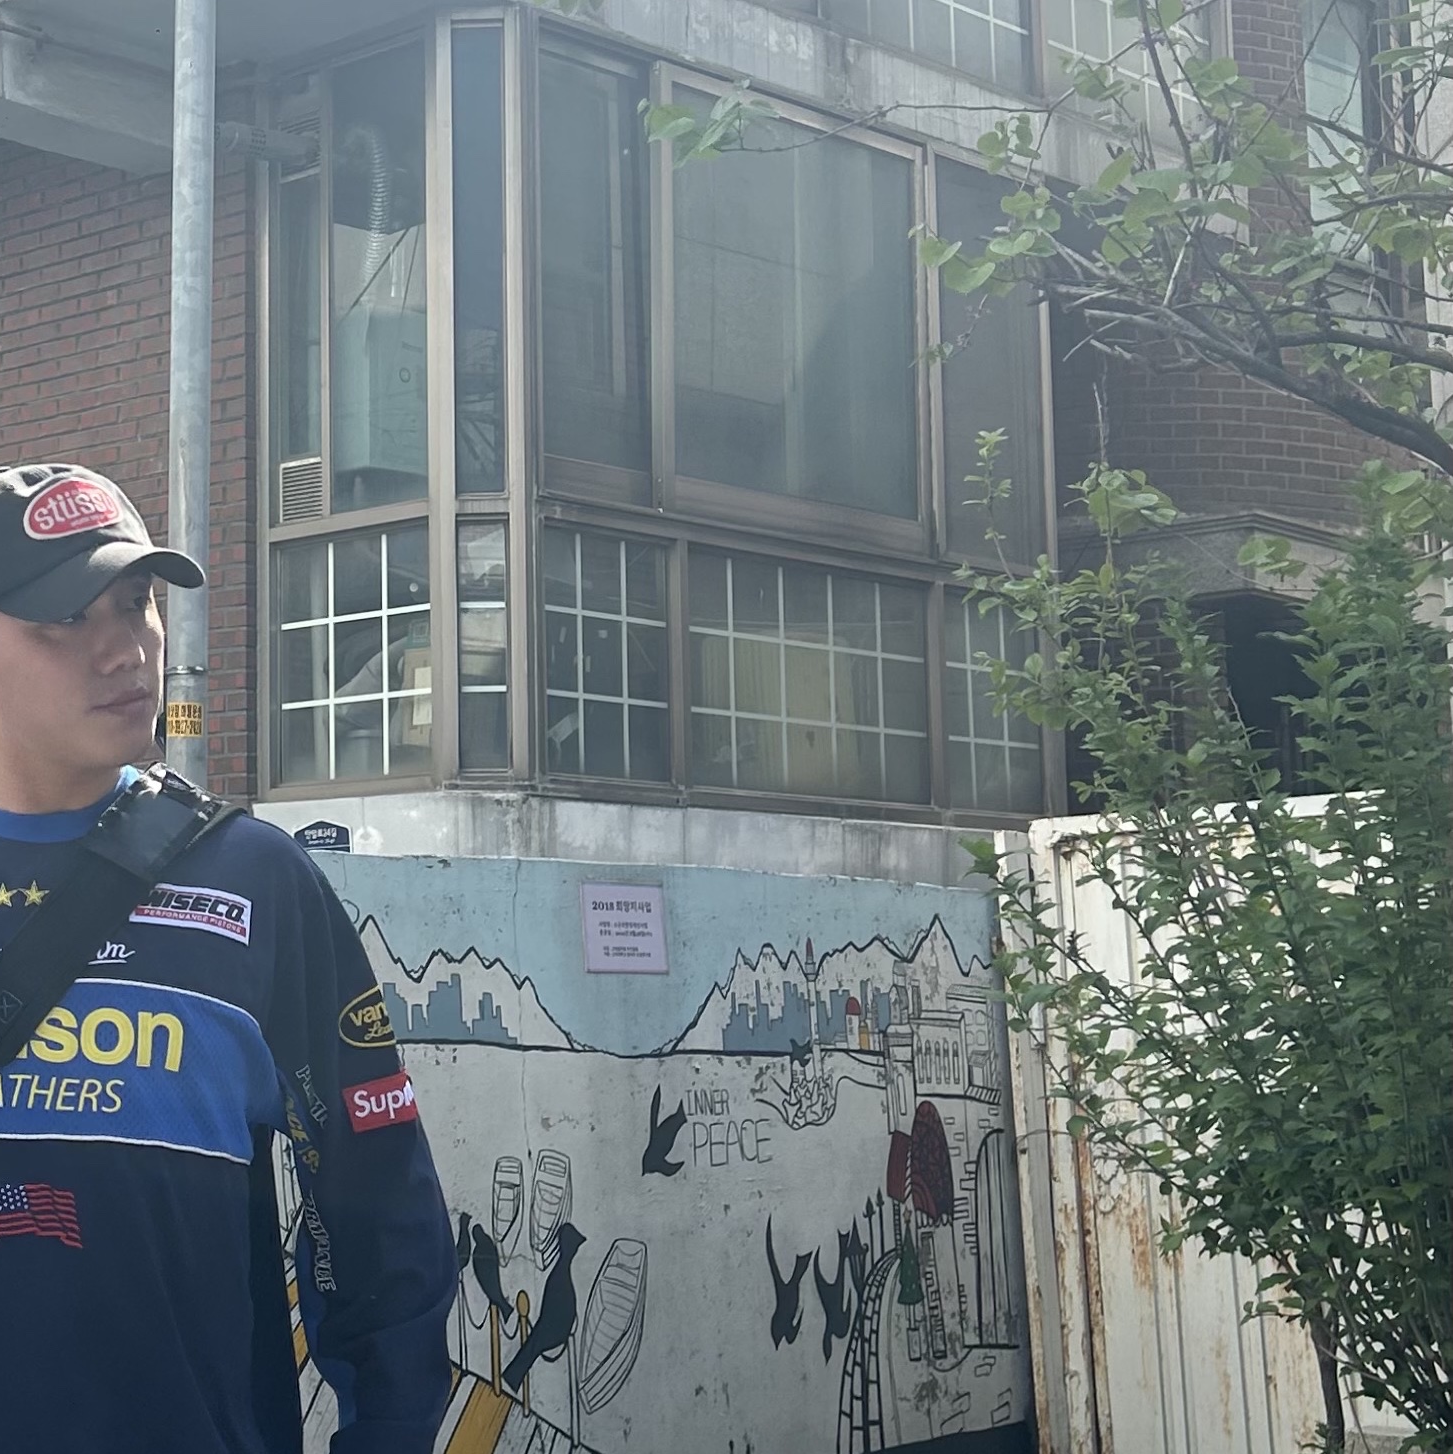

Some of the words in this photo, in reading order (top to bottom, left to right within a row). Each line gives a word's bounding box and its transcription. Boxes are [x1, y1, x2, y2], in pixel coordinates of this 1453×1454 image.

[591, 900, 615, 911] 2018
[685, 1088, 731, 1117] INNER
[692, 1118, 774, 1168] PEACE
